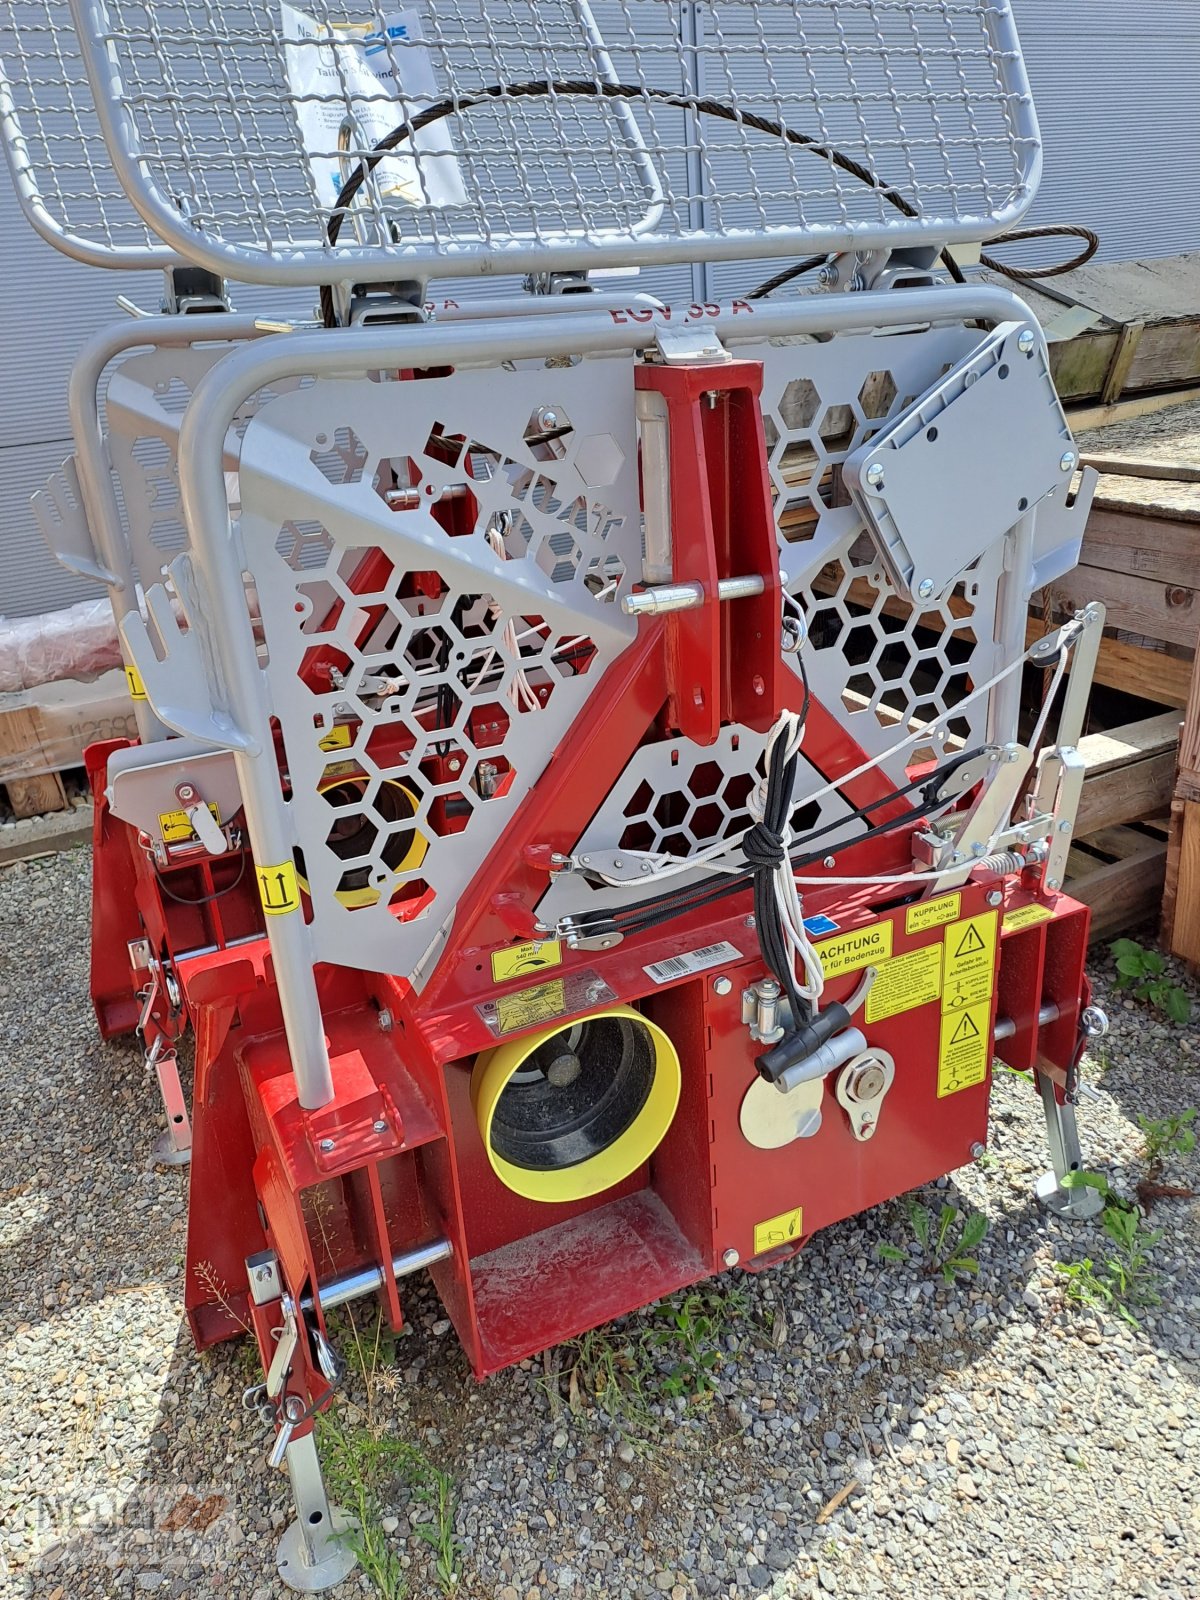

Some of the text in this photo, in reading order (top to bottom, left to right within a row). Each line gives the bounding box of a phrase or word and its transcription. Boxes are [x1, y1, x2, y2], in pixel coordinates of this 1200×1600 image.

[913, 900, 954, 918] KUPPLUNG
[909, 910, 957, 930] ein aus
[820, 933, 880, 960] ACHTUNG
[830, 959, 842, 969] für
[844, 946, 885, 965] Bodenzug
